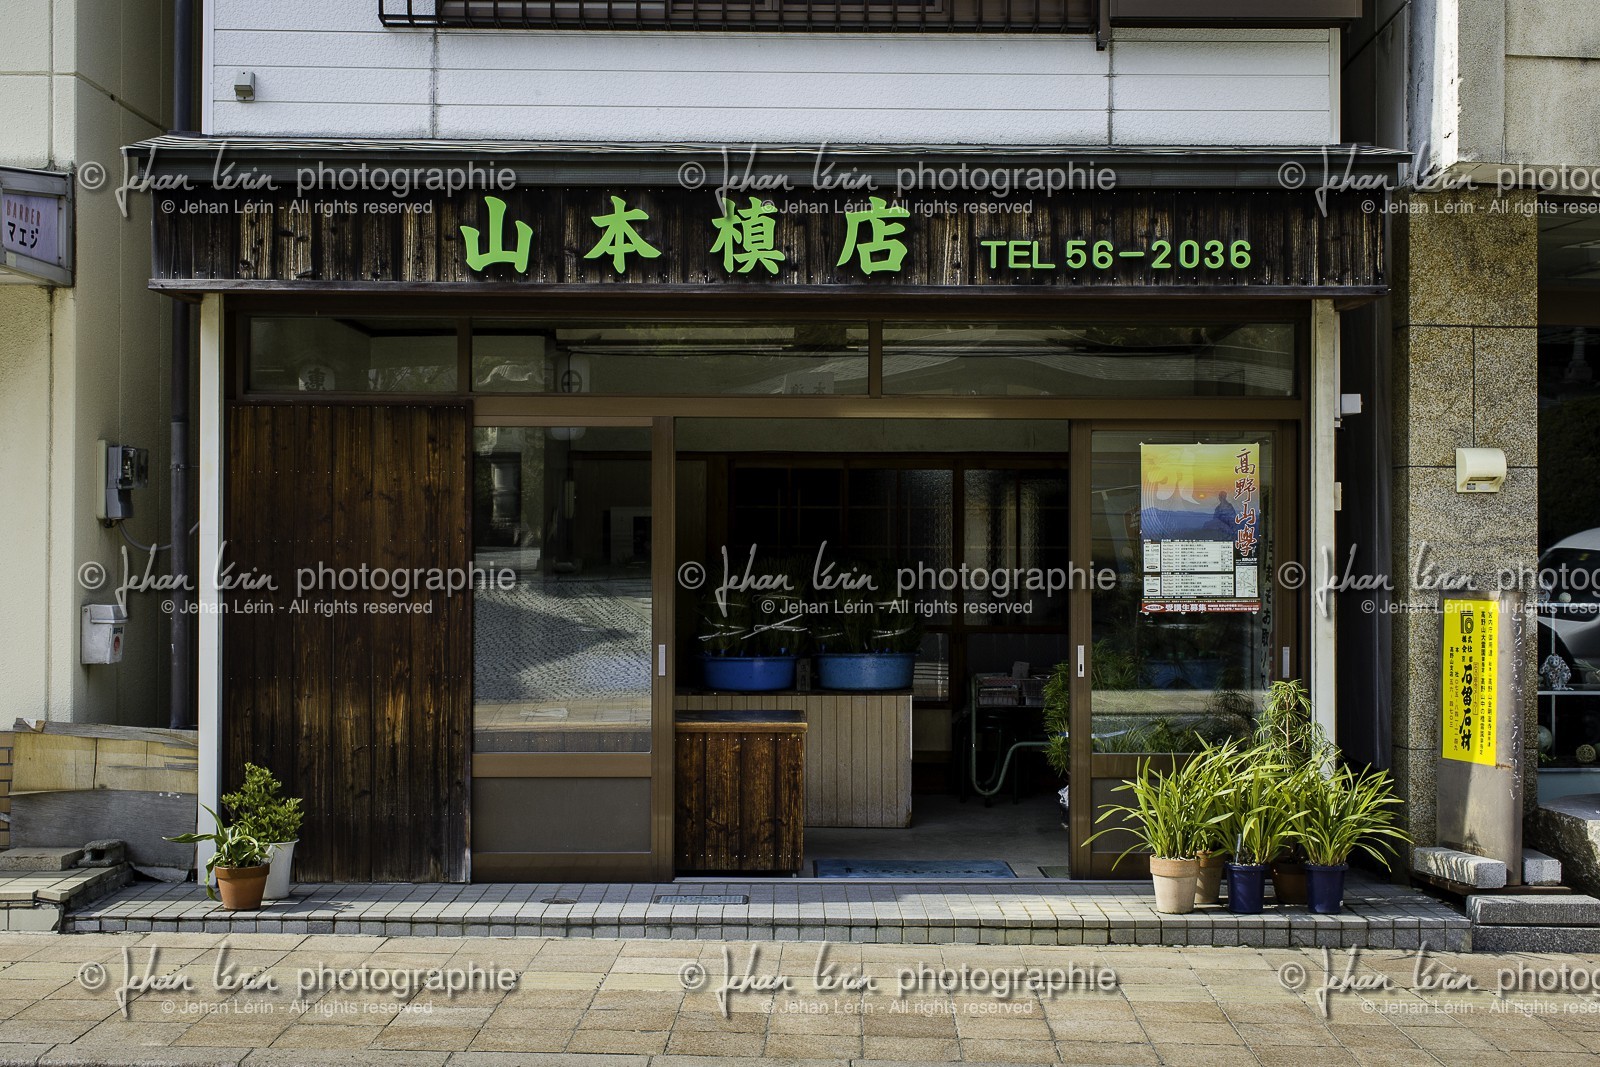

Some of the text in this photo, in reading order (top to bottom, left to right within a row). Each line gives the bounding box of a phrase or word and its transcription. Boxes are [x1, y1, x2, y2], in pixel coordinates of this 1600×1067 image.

[6, 199, 42, 226] BARBER
[7, 221, 39, 249] マエジ
[981, 240, 1055, 271] TEL
